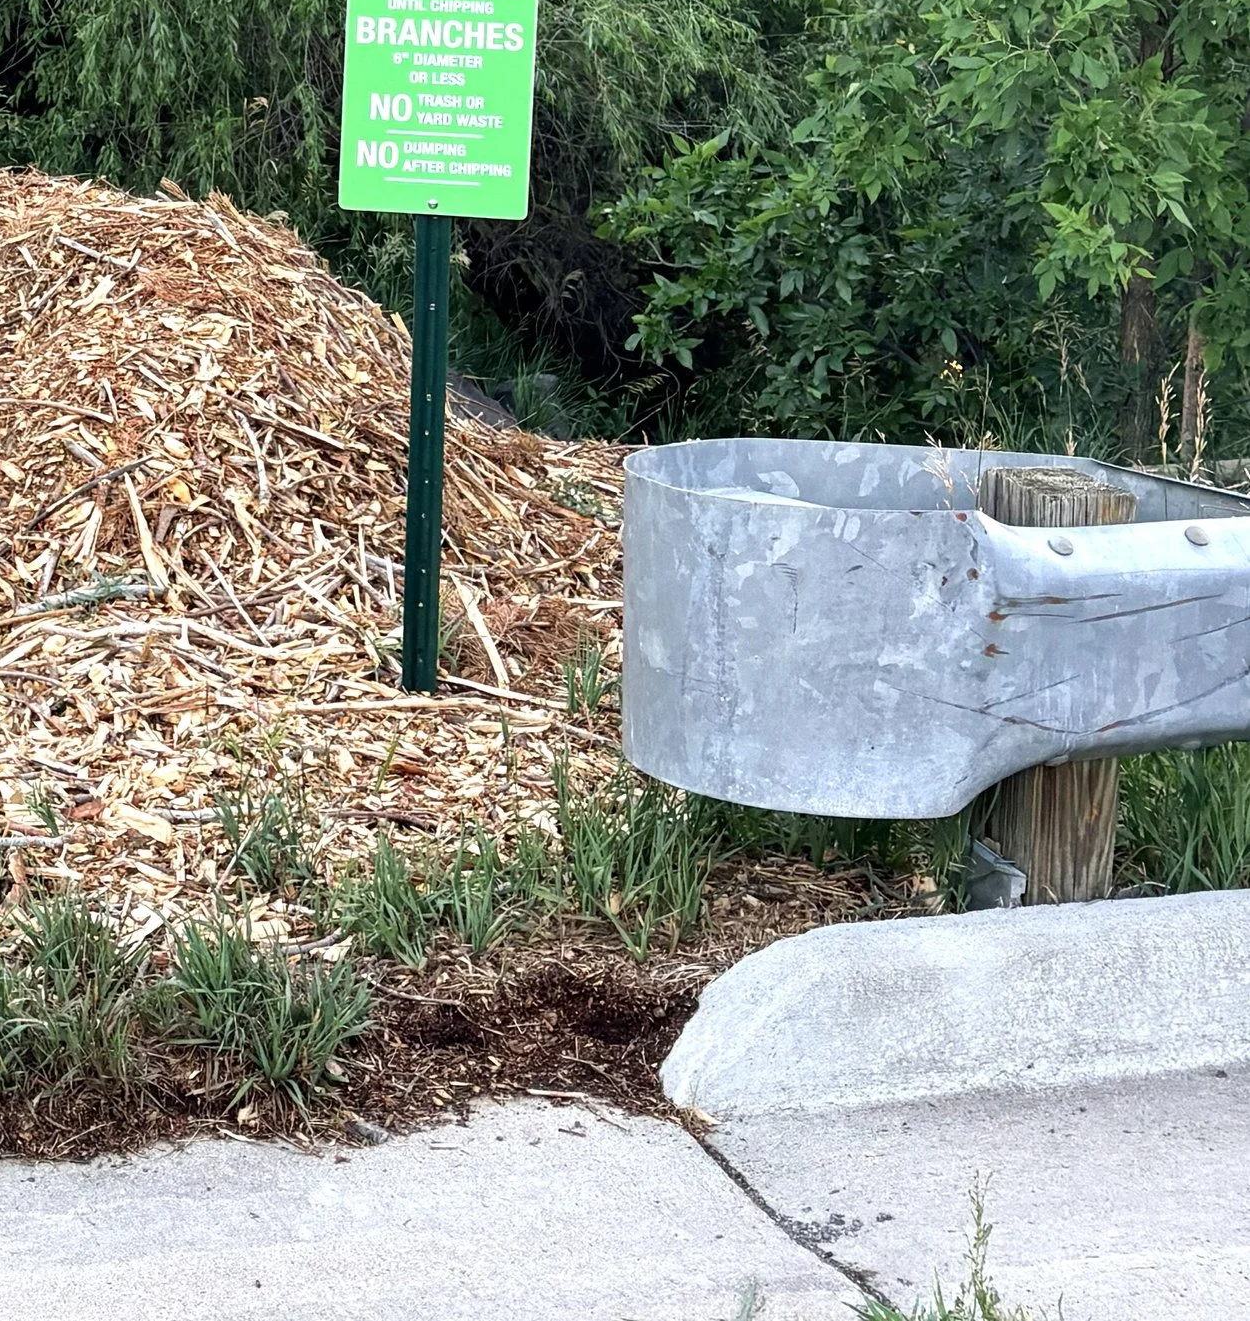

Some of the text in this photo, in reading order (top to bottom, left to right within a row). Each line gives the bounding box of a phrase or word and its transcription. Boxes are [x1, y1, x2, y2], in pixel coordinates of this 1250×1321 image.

[430, 0, 494, 14] CHIPPING
[357, 16, 524, 51] BRANCHES
[414, 53, 482, 68] DIAMETER
[410, 71, 465, 86] OR LESS
[370, 93, 412, 121] NO
[418, 94, 484, 109] TRASH OR
[417, 112, 502, 128] YARD WASTE
[357, 140, 399, 168] NO
[404, 141, 466, 156] DUMPING
[403, 160, 511, 177] AFTER CHIPPING
